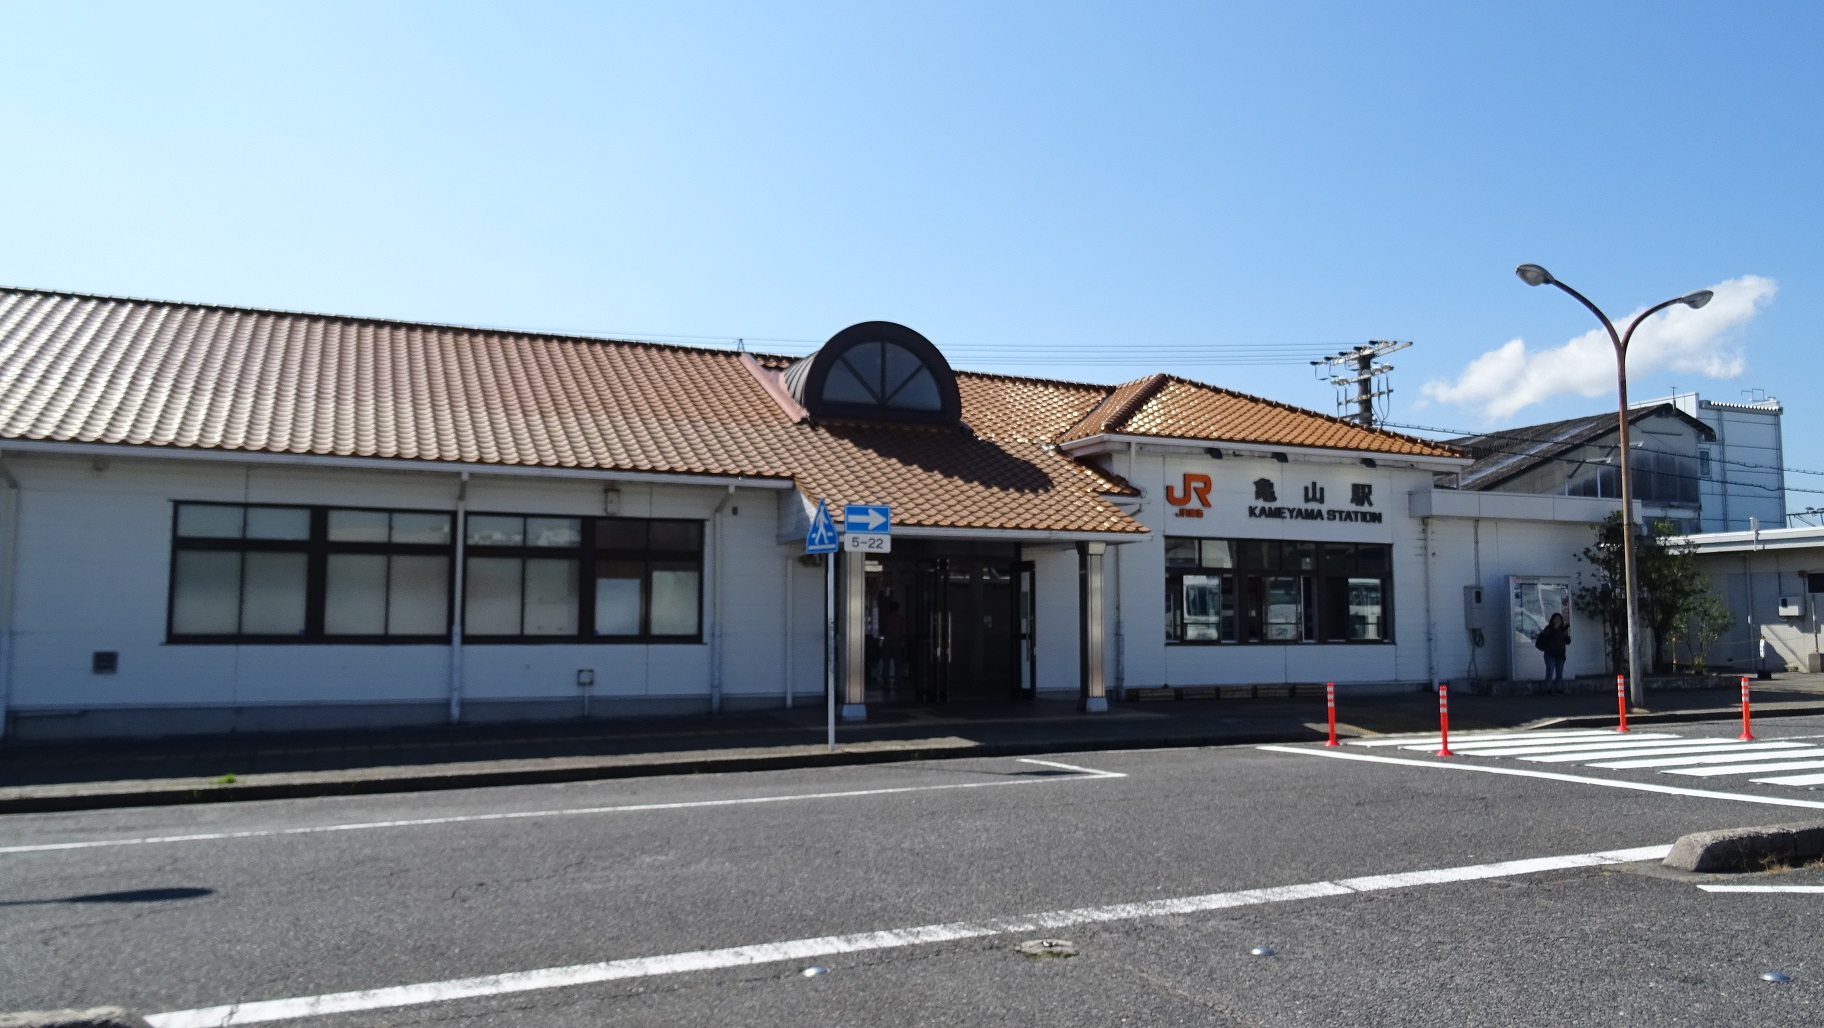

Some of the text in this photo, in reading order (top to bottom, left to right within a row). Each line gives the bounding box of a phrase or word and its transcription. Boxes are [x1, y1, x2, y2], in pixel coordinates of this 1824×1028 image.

[1166, 474, 1212, 508] JR
[1248, 505, 1383, 523] KAMEYAMA STATION
[851, 537, 884, 549] 5-22
